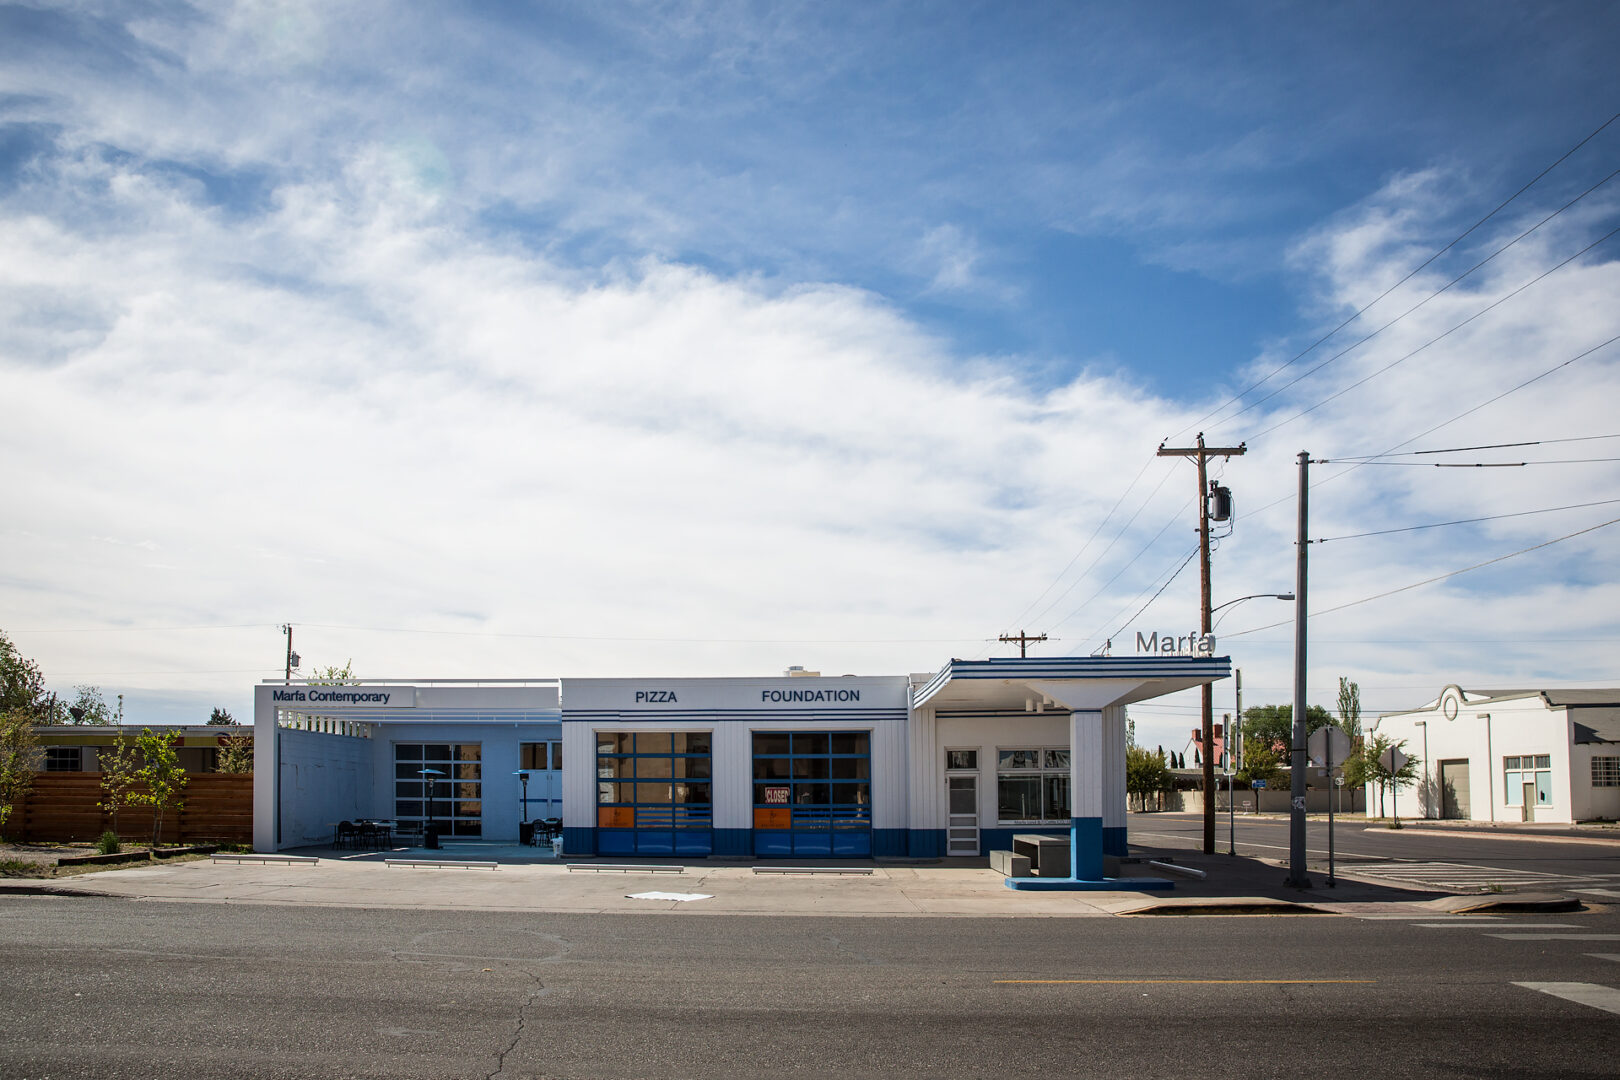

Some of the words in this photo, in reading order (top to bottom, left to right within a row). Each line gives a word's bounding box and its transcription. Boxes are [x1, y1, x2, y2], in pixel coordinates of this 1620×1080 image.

[1136, 631, 1212, 652] Marfa
[273, 690, 305, 702] Marfa
[309, 690, 390, 704] Contemporary
[636, 691, 677, 703] PIZZA
[762, 690, 860, 702] FOUNDATION
